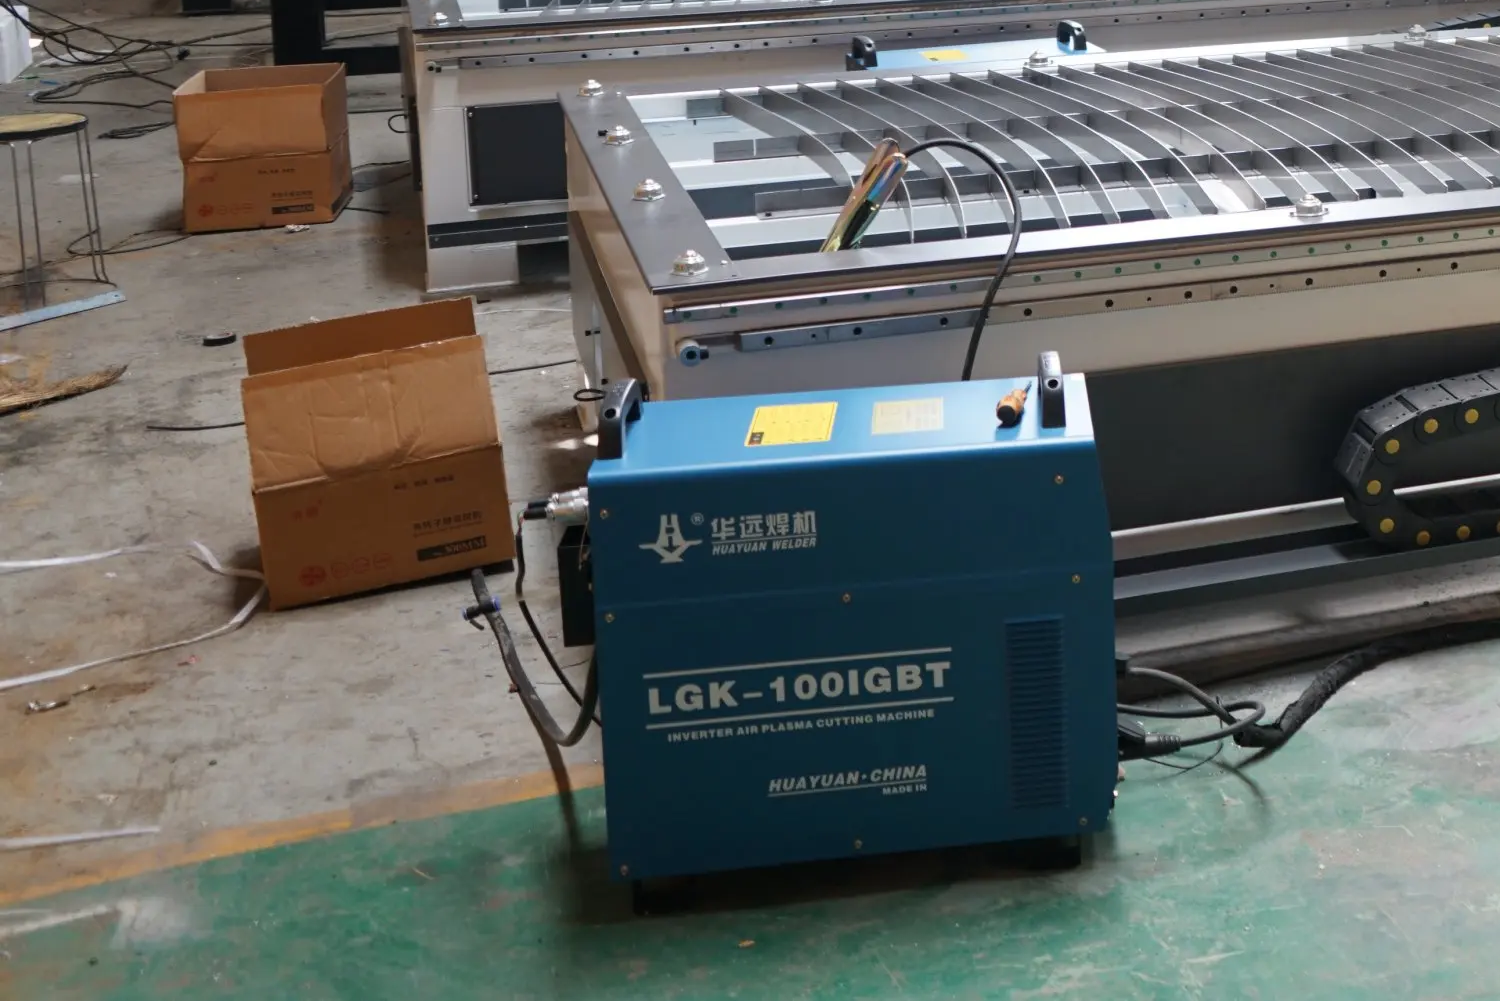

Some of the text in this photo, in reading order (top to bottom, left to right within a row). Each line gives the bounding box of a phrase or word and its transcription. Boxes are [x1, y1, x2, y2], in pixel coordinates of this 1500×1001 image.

[711, 511, 817, 540] 华远焊机
[712, 537, 817, 556] HUAYUAN WELDER
[667, 708, 934, 742] INVERTER AIR PLASMA CUTTING MACHINE
[882, 784, 927, 796] MADE IN
